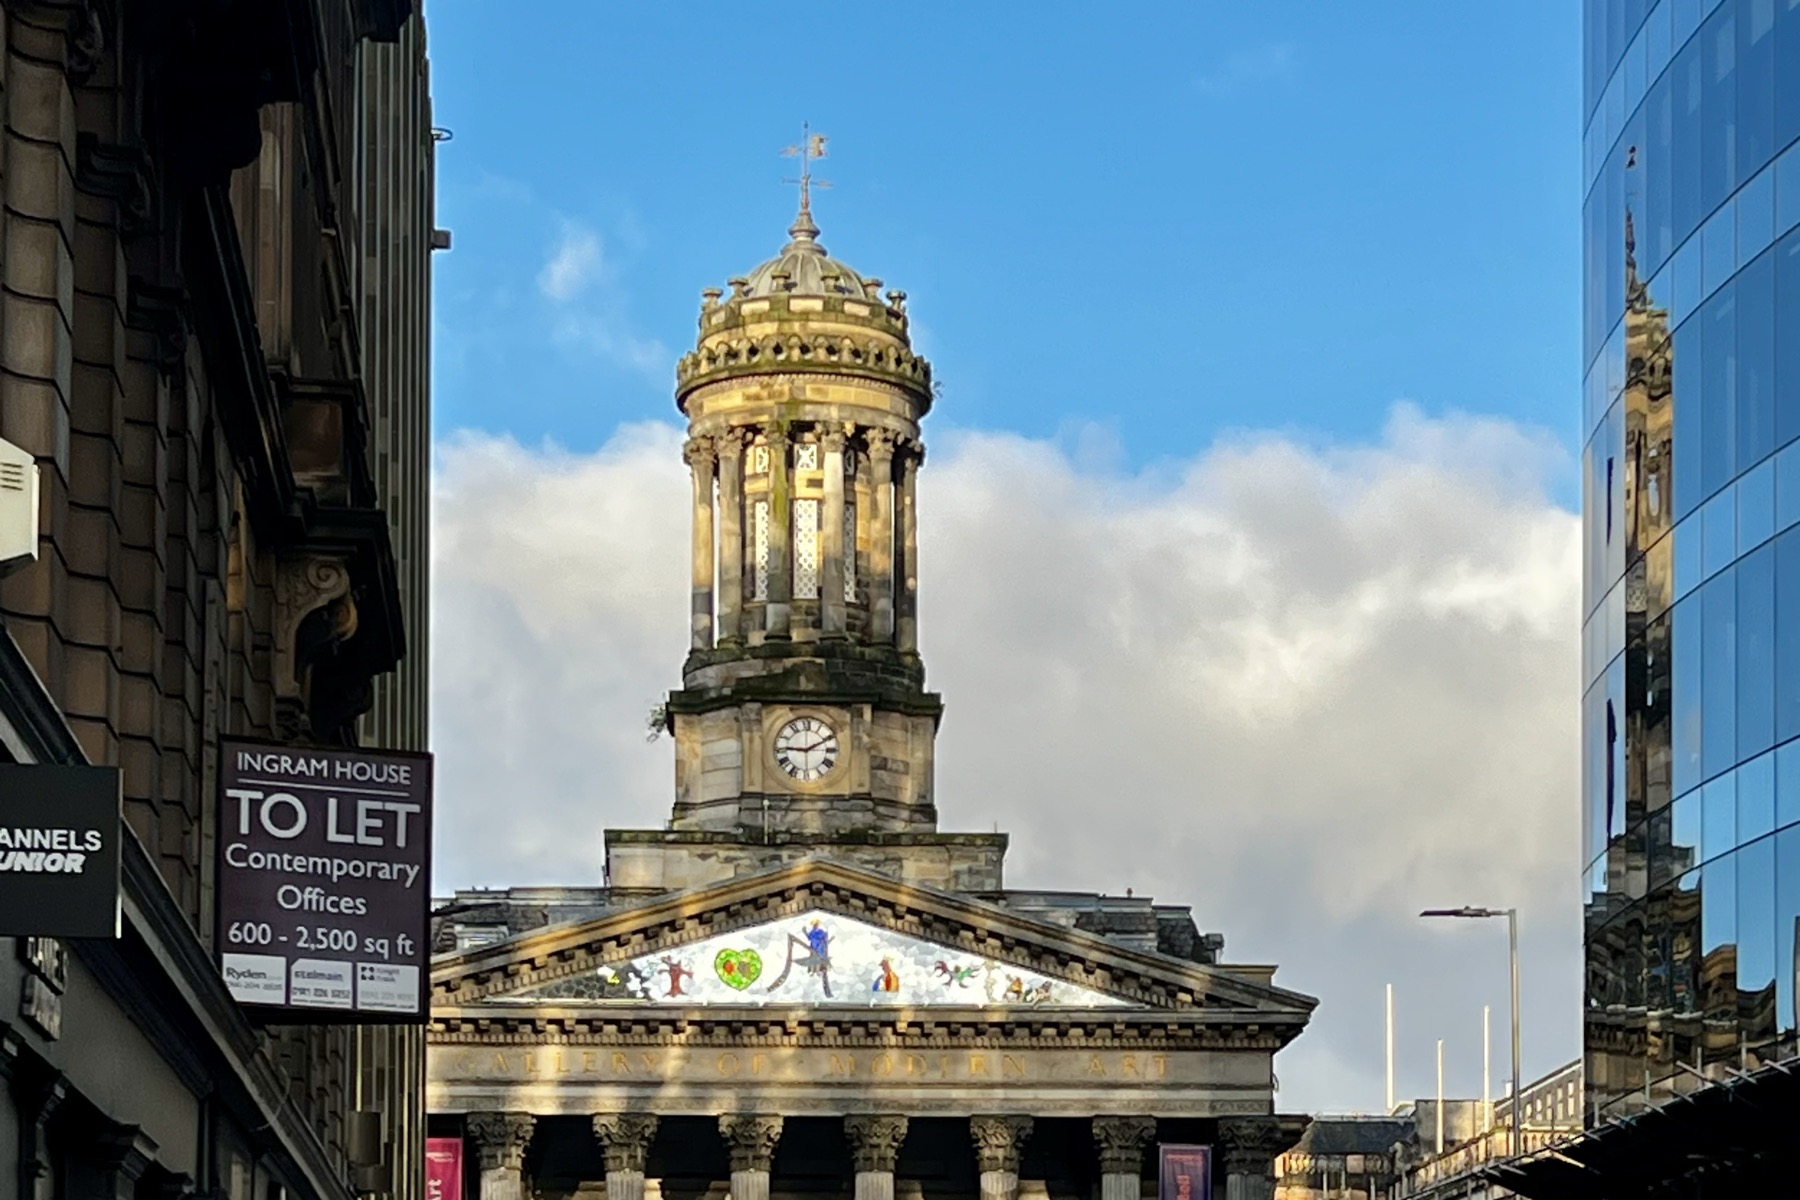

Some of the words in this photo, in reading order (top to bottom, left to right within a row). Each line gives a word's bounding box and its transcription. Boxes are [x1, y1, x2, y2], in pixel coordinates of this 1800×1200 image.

[237, 751, 328, 778] INGRAM
[334, 760, 411, 785] HOUSE
[226, 788, 307, 839] TO
[326, 797, 421, 848] LET
[0, 827, 102, 851] ANNELS
[225, 843, 420, 888] Contemporary
[276, 884, 368, 915] Offices
[228, 921, 272, 945] 600
[295, 925, 358, 951] 2,500
[363, 936, 389, 960] sq
[396, 934, 415, 956] ft
[225, 966, 267, 981] Ryden
[455, 1050, 665, 1076] GALLERY
[716, 1052, 769, 1076] OF
[829, 1052, 1027, 1077] MODERN
[1087, 1052, 1170, 1077] ART
